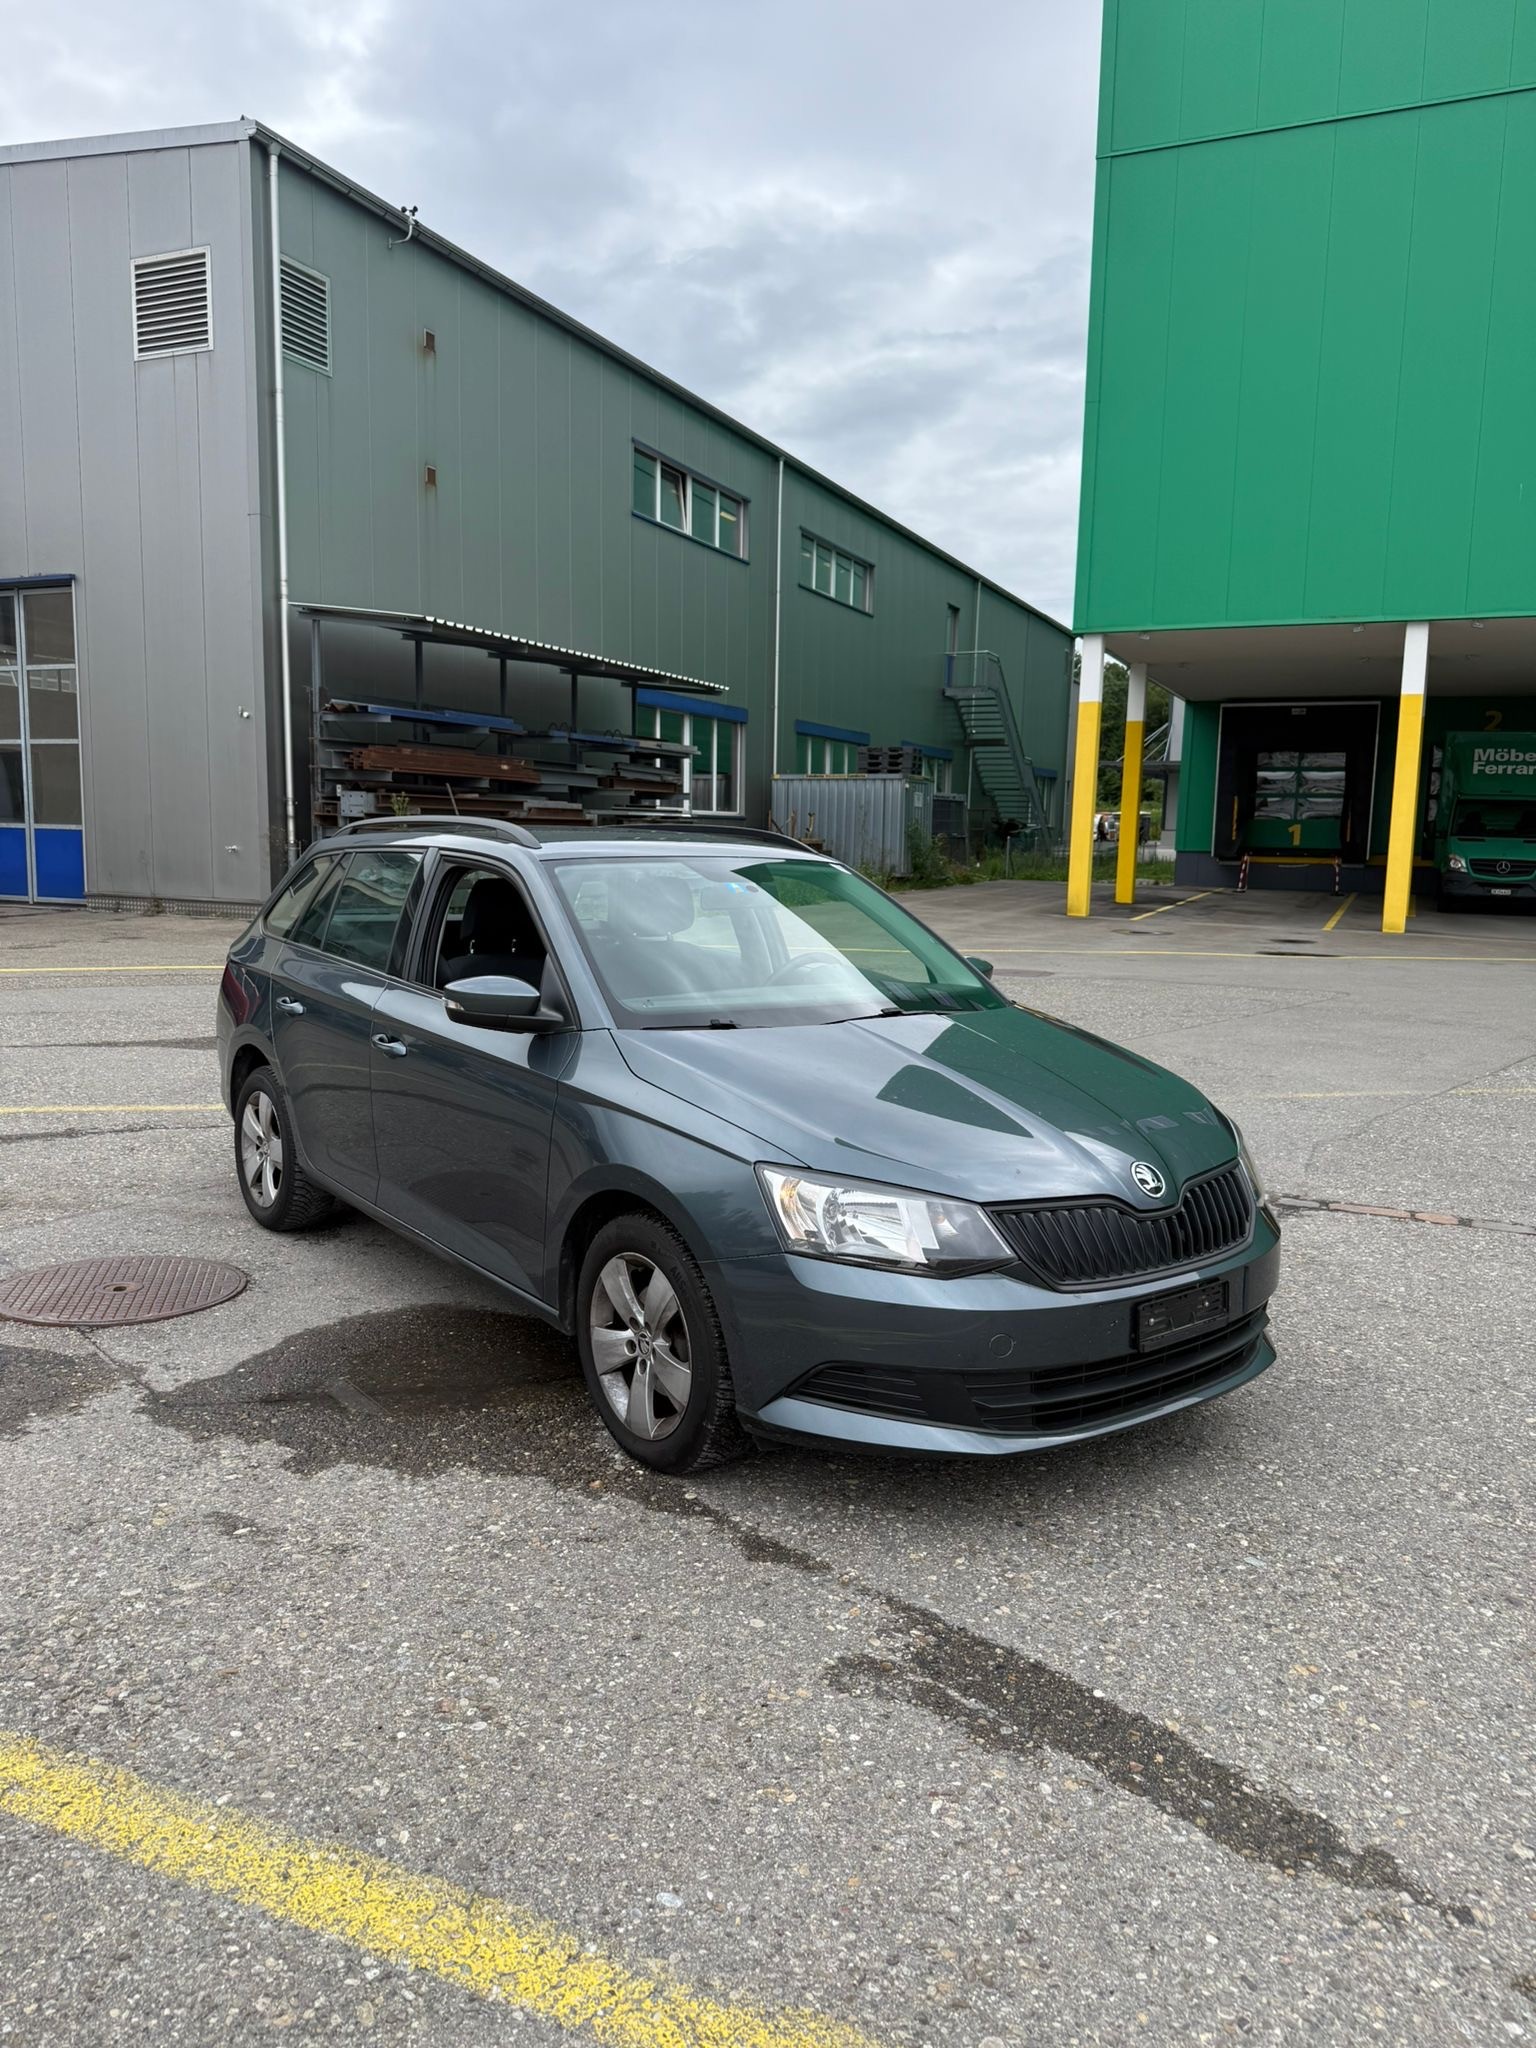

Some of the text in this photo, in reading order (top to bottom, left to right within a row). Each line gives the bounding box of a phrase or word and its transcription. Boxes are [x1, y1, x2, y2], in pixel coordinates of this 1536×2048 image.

[1484, 710, 1502, 731] 2
[1473, 748, 1536, 762] Möbe
[1287, 823, 1301, 846] 1
